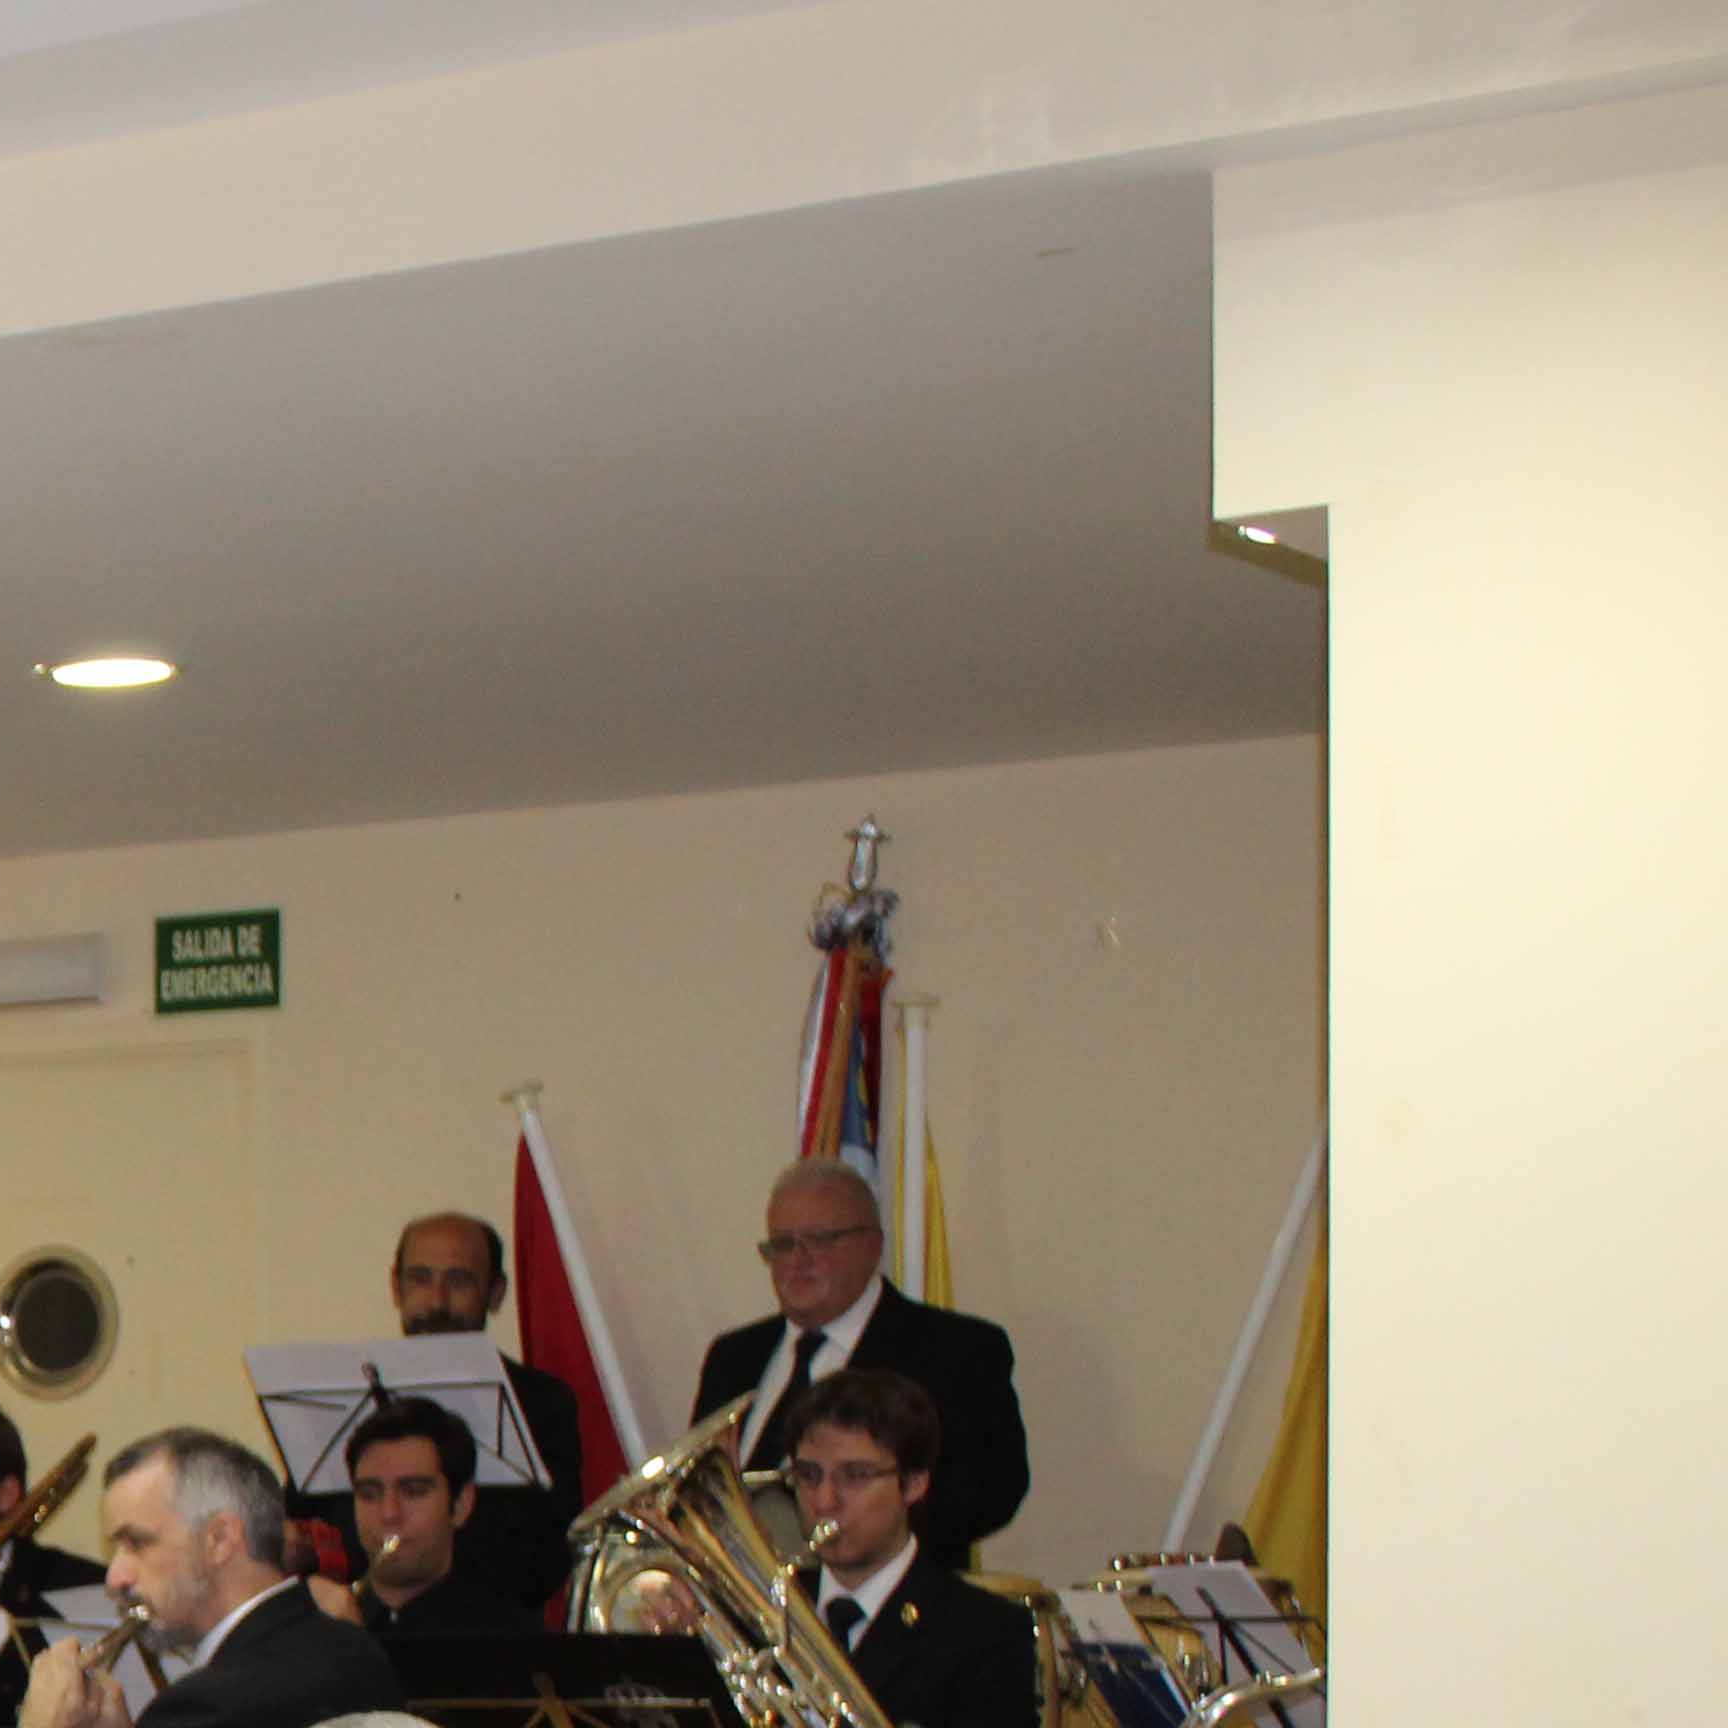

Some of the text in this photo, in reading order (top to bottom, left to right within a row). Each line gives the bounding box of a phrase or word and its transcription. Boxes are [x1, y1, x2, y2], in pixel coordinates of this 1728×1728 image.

[171, 924, 263, 962] SALIDA DE
[160, 963, 273, 1001] EMERGENCIA
